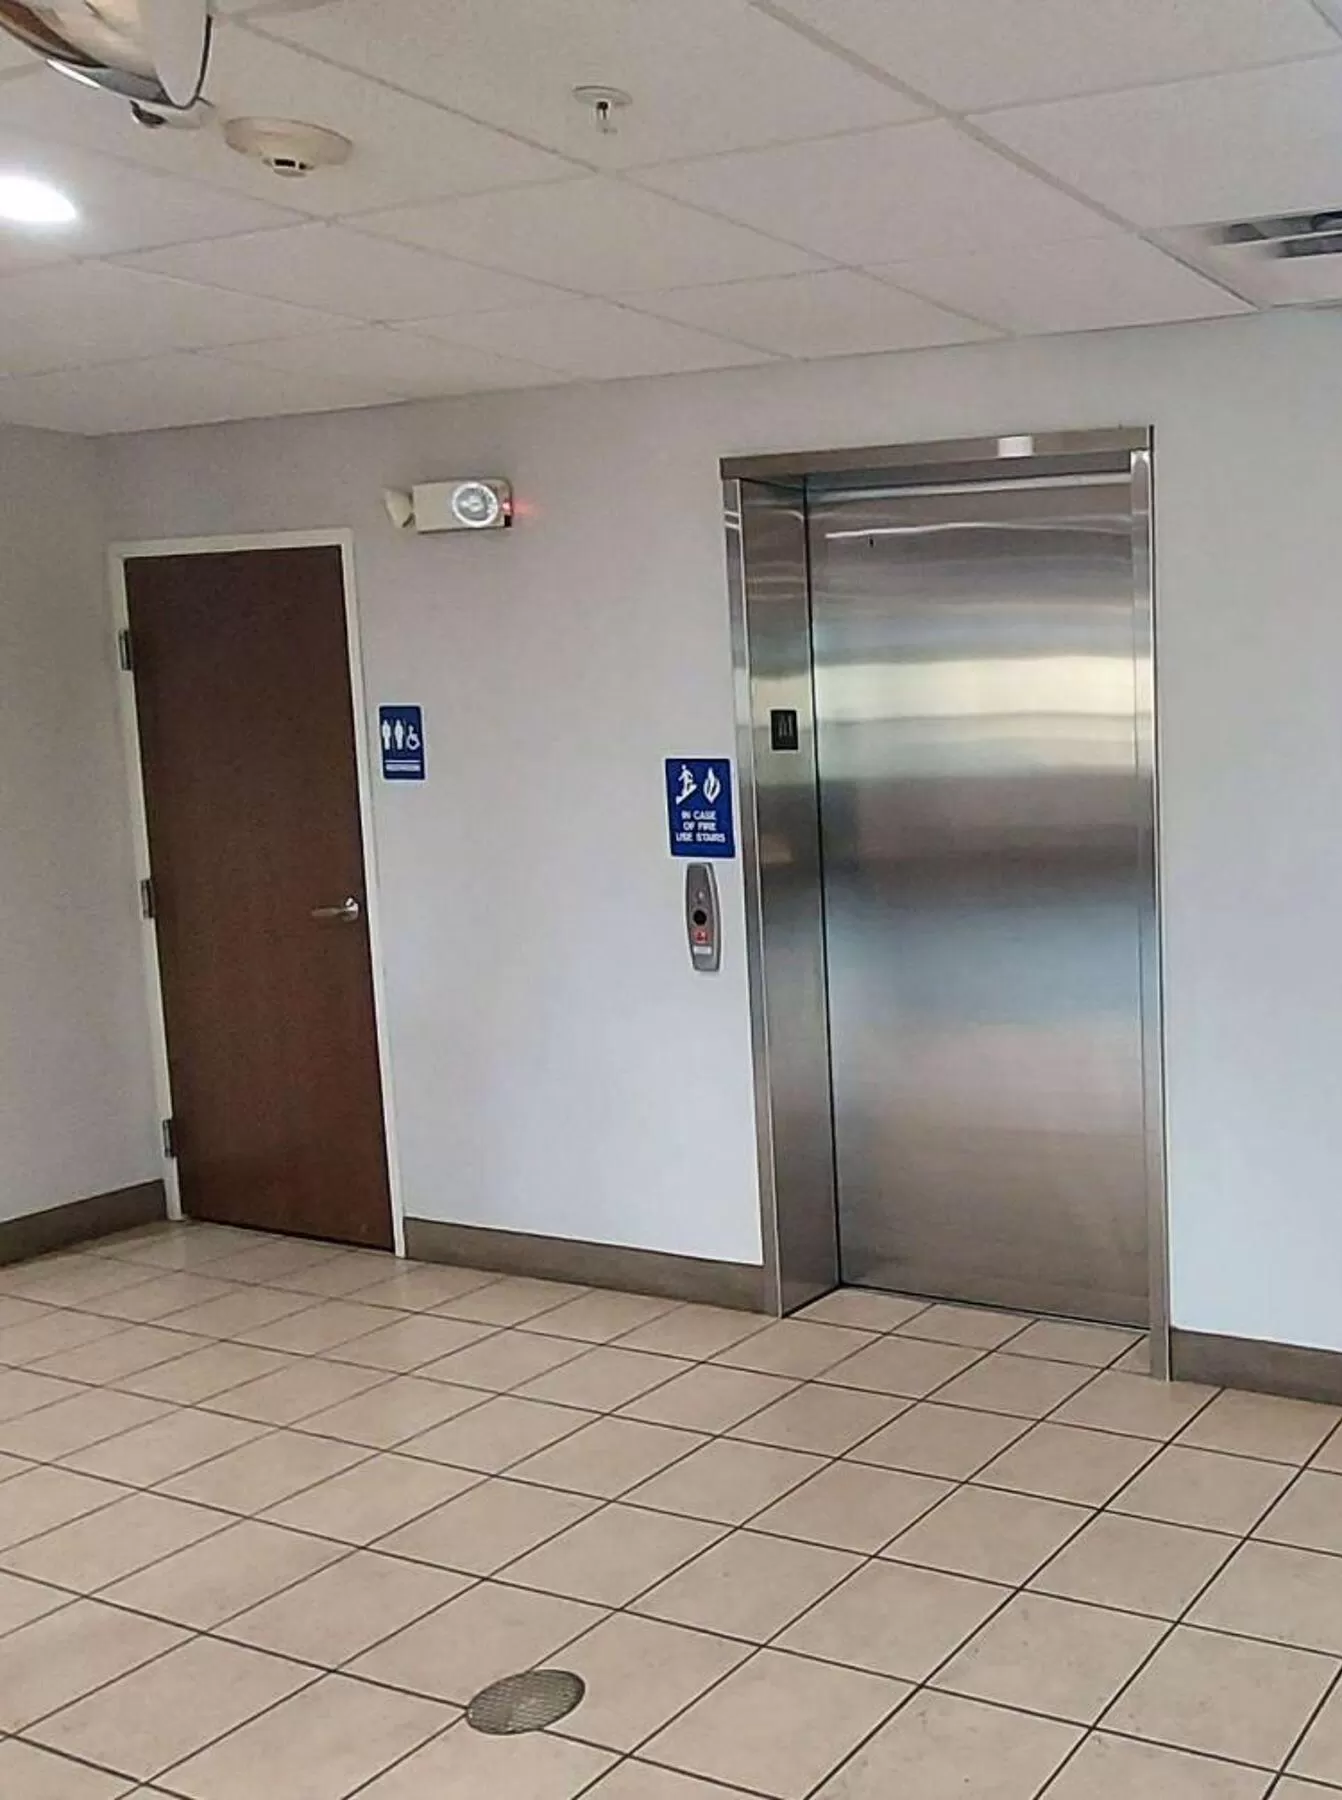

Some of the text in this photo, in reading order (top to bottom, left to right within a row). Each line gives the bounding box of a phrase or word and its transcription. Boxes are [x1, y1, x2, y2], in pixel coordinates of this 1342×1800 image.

[681, 810, 717, 820] IN CASE
[683, 821, 717, 831] OF FIRE
[675, 832, 726, 843] USE STAIRS
